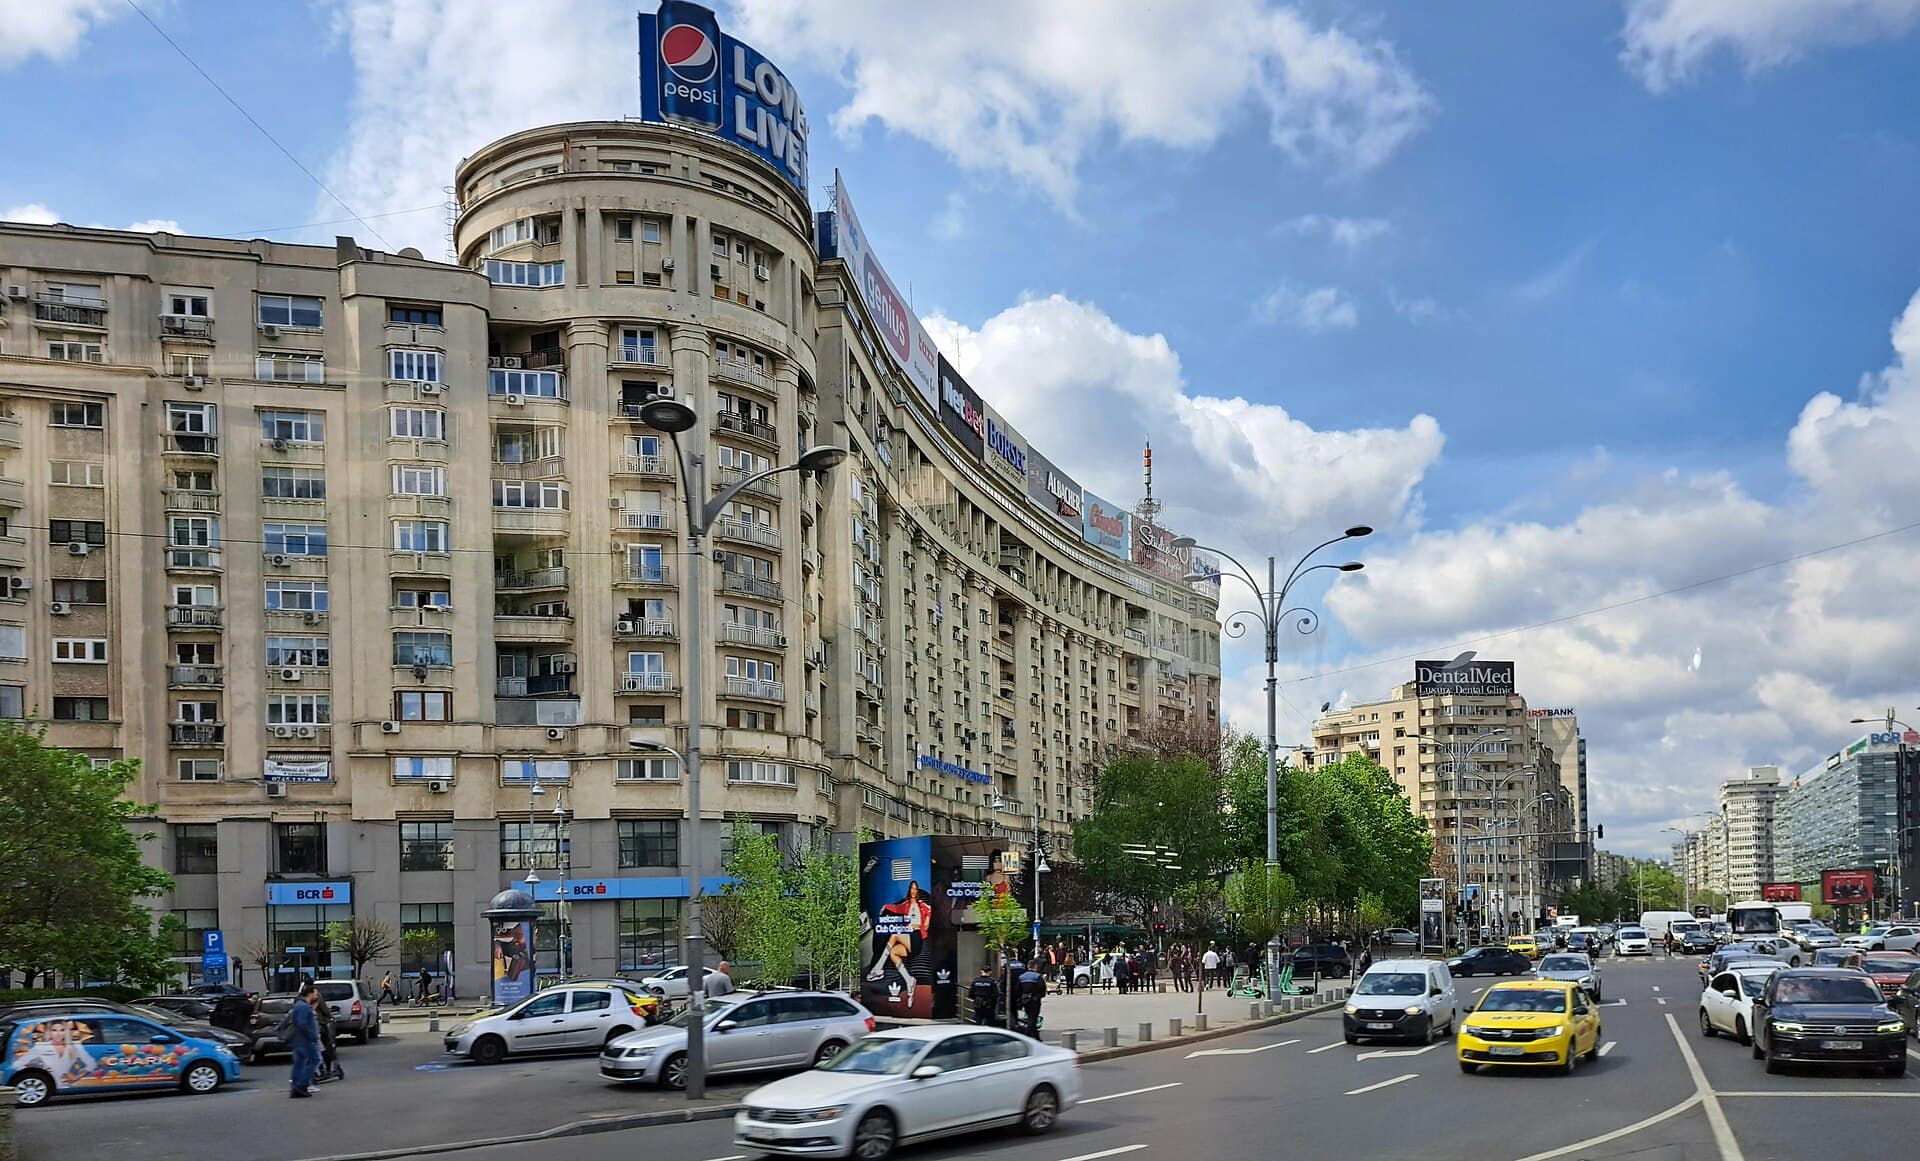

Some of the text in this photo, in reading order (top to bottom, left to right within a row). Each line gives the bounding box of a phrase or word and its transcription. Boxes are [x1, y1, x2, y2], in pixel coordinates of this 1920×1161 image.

[664, 82, 717, 105] pepsi
[734, 45, 806, 142] LOVE
[735, 95, 802, 178] LIVE
[867, 270, 906, 347] genius
[943, 375, 984, 440] NetBet
[987, 418, 1027, 475] BORSEC
[1047, 470, 1082, 516] ALBACHER
[1139, 525, 1171, 555] Studio
[1418, 667, 1512, 684] DentalMed
[1419, 685, 1512, 695] Luxury Dental Clinic
[1870, 732, 1901, 745] BCR
[296, 889, 320, 900] BCR
[573, 885, 594, 895] BCR
[207, 933, 219, 947] P
[875, 924, 889, 933] Club
